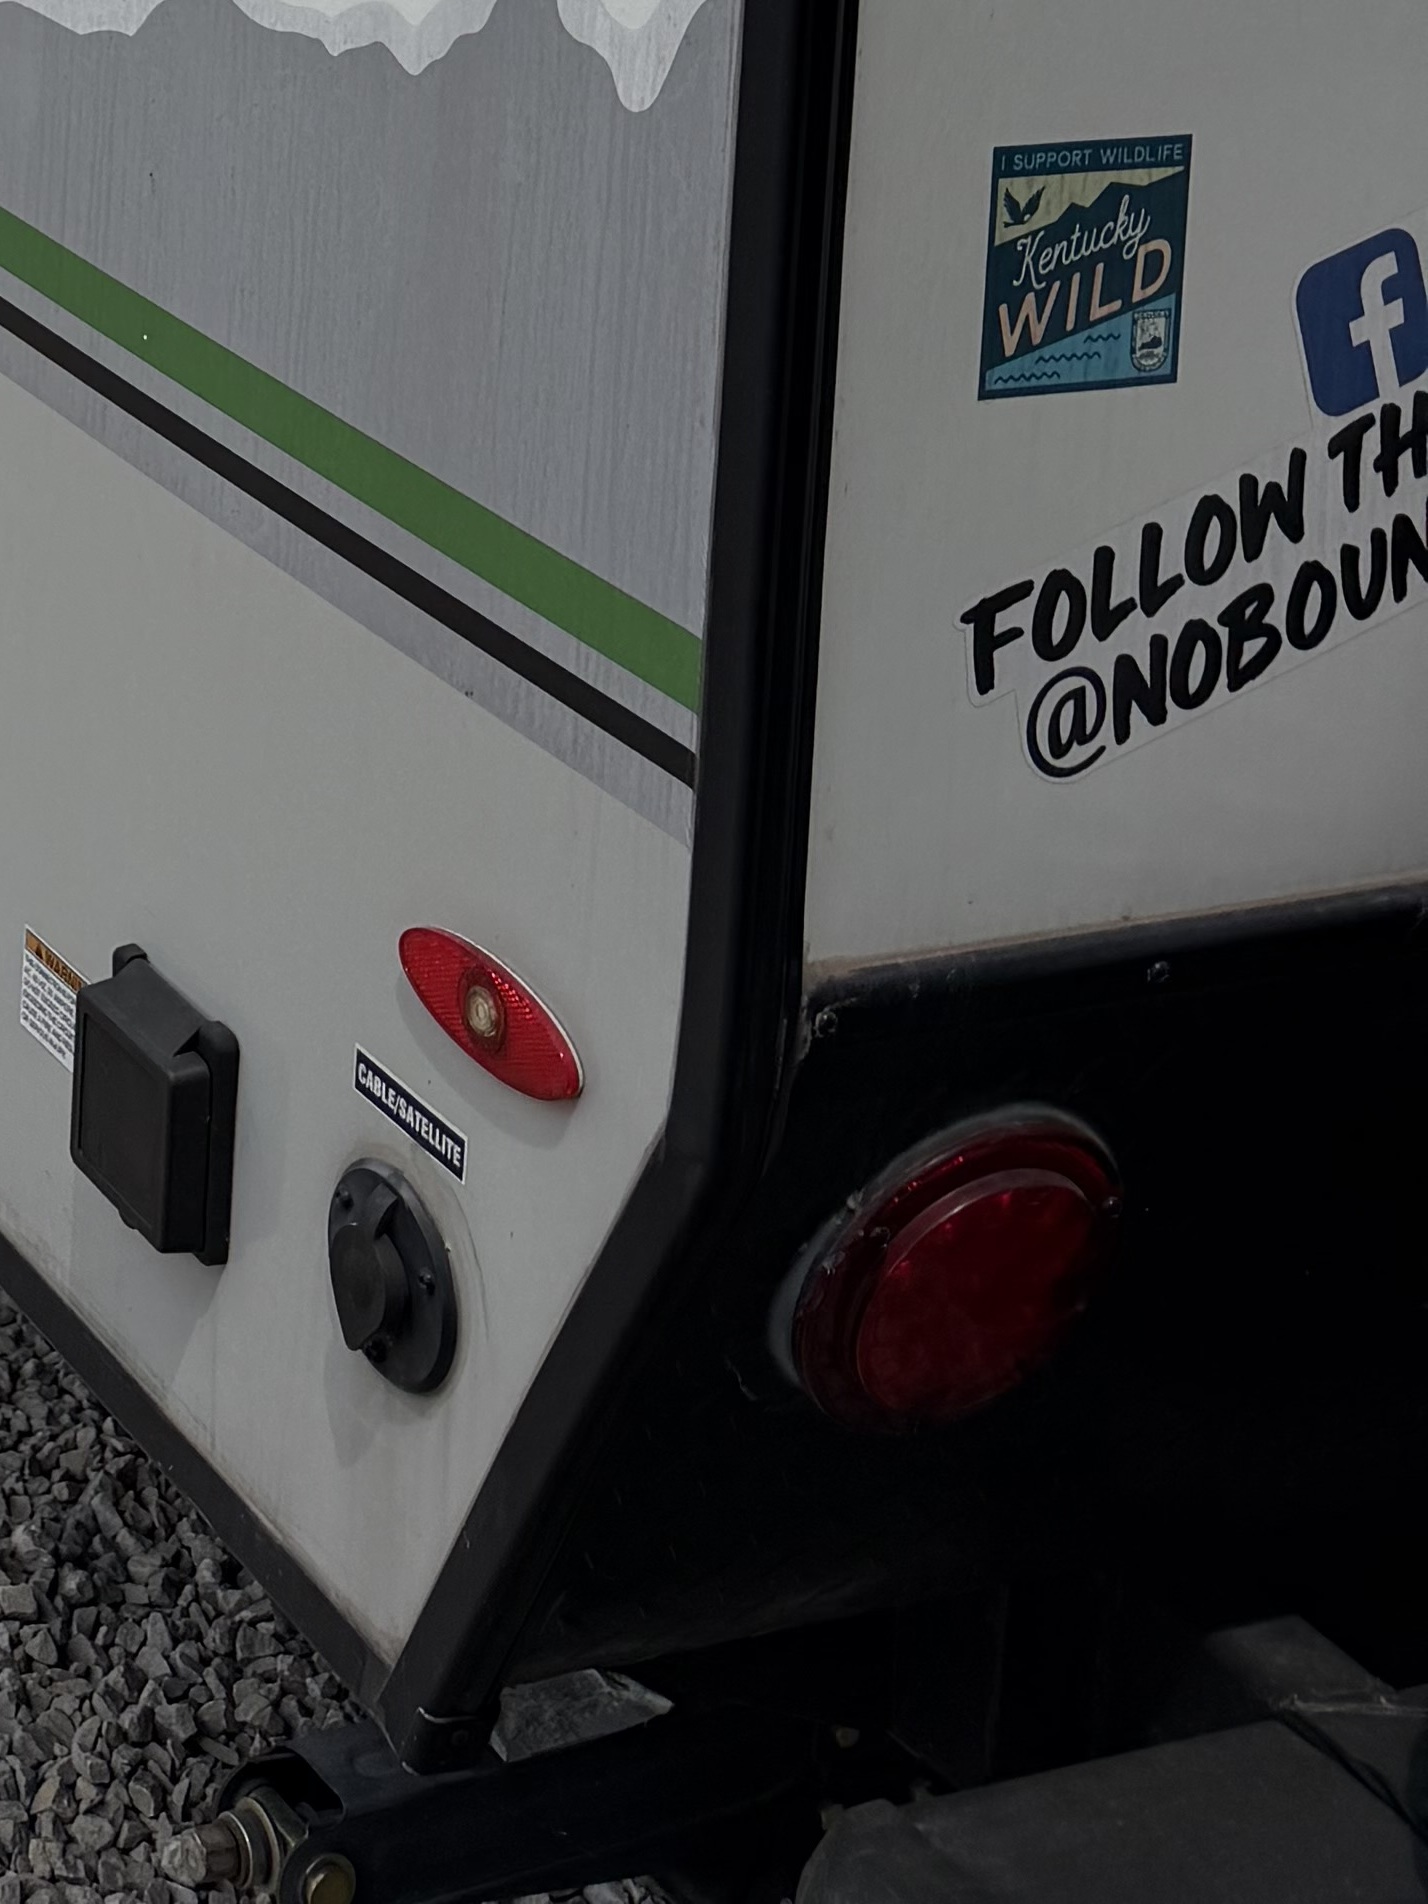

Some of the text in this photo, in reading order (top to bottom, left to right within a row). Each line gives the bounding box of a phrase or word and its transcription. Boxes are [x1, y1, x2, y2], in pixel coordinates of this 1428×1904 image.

[1014, 149, 1093, 172] SUPPORT
[1101, 143, 1185, 165] WILDLIFE
[1013, 193, 1152, 290] Kentucky
[997, 239, 1173, 358] WILD
[959, 390, 1428, 697] FOLLOW TH
[1026, 512, 1428, 779] @NOBOUN
[357, 1062, 462, 1167] CABLE/SATELLITE
